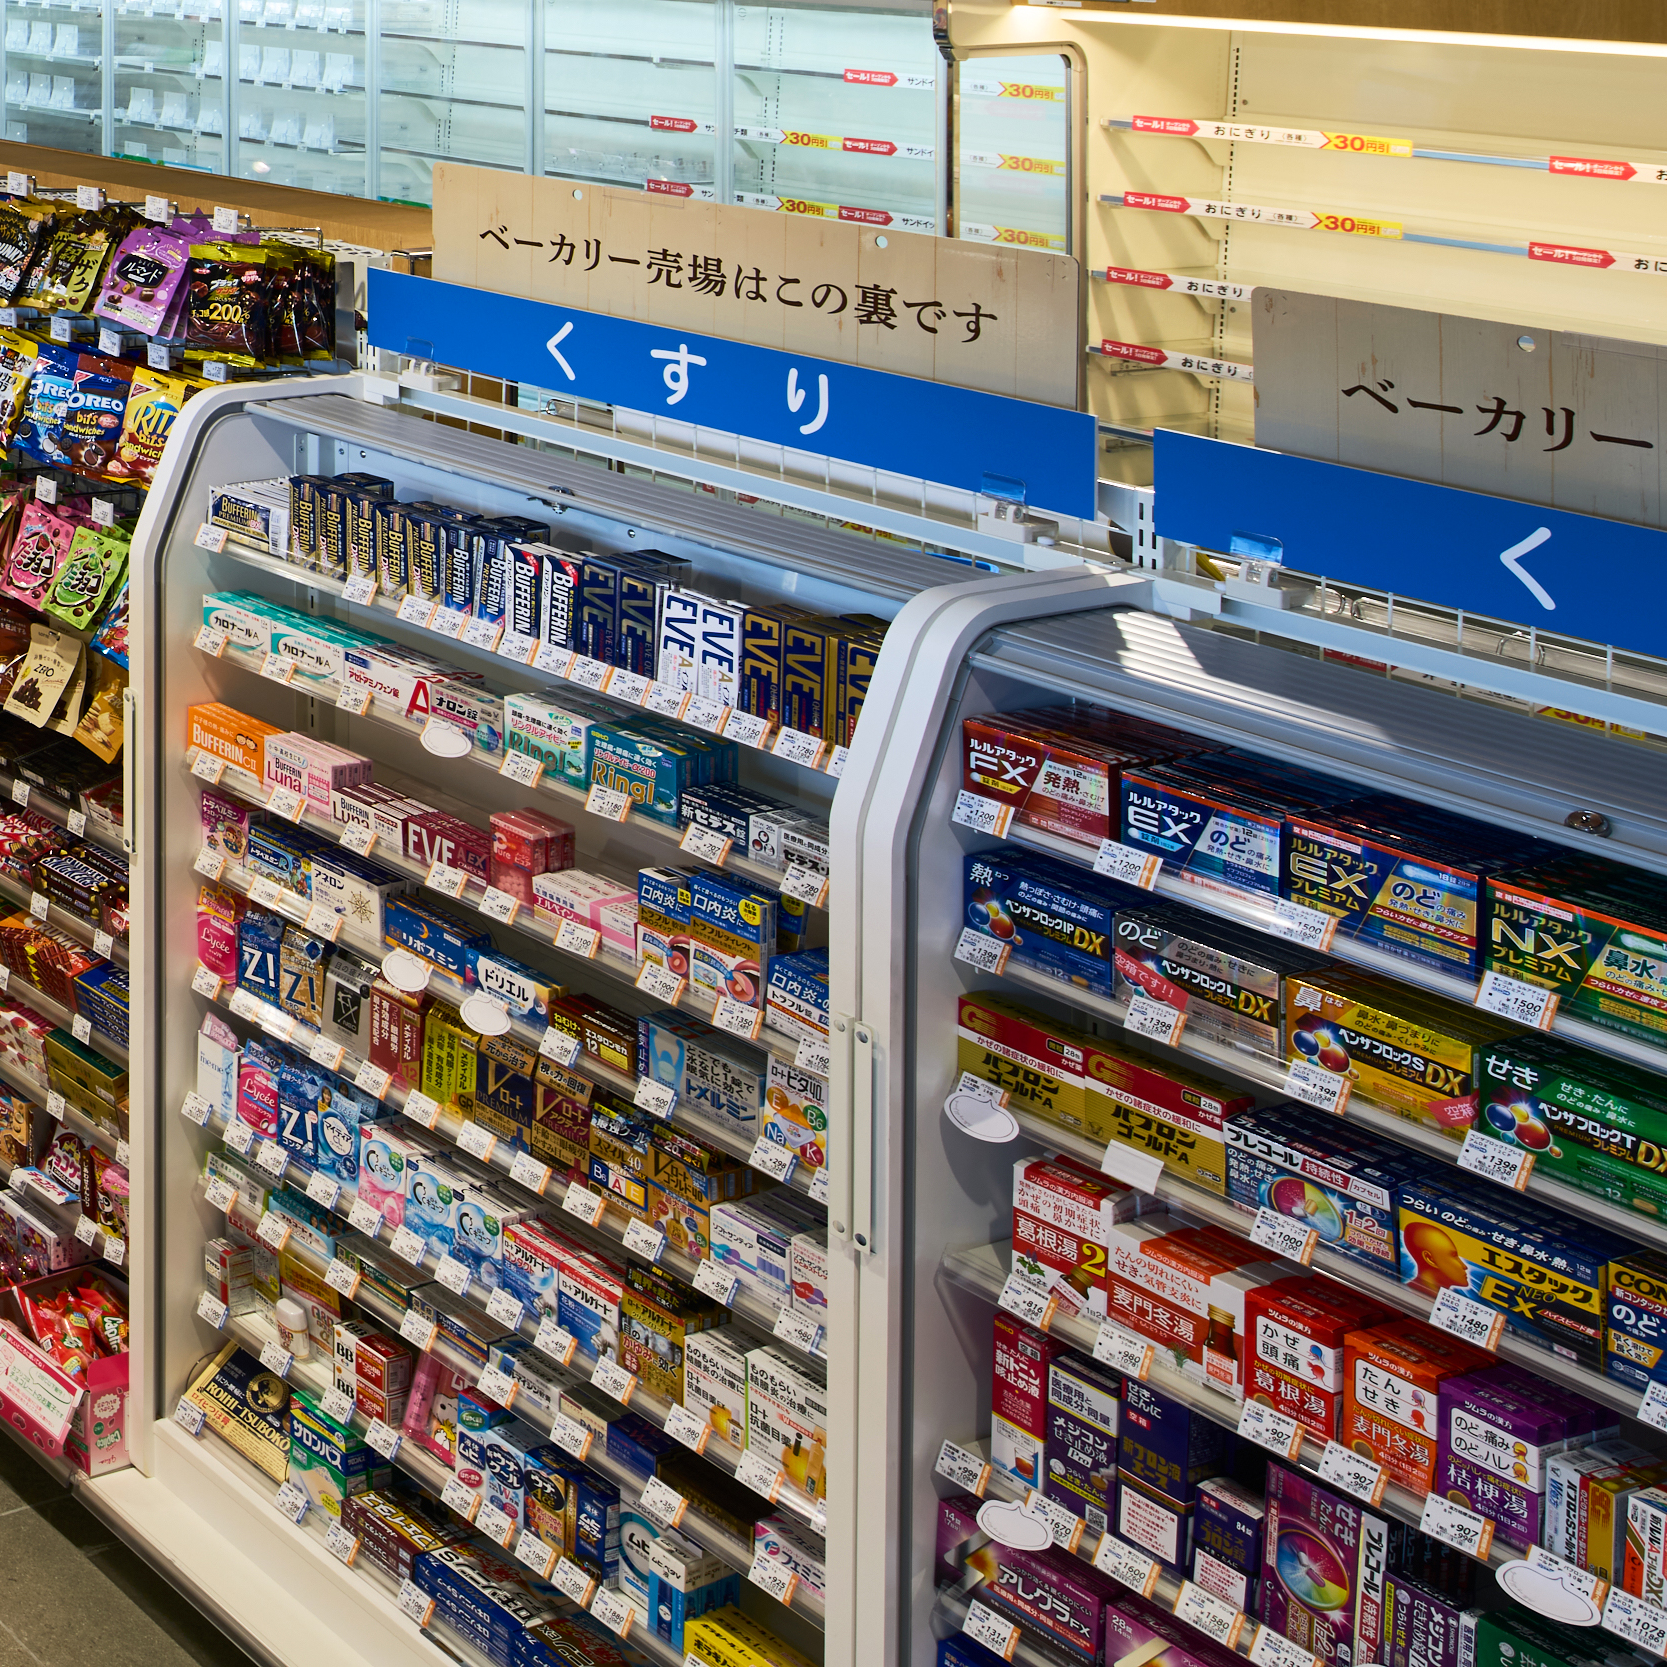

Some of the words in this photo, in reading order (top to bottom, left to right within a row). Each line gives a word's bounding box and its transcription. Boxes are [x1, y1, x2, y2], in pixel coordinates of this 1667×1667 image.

[1009, 84, 1054, 99] 30円引
[789, 133, 828, 147] 30円引
[1134, 116, 1168, 132] セール!
[1214, 124, 1272, 142] おにぎり
[1333, 133, 1391, 155] 30円引
[1008, 156, 1054, 172] 30円引
[785, 200, 825, 216] 30円引
[1125, 193, 1158, 208] セール!
[1205, 203, 1263, 220] おにぎり
[1323, 213, 1383, 236] 30円引
[123, 262, 163, 284] ルマンド
[478, 223, 998, 345] ベーカリー売場はこの裏です
[1107, 268, 1140, 283] セール!
[1186, 280, 1244, 299] おにぎり
[547, 322, 829, 434] くすり
[1181, 357, 1240, 376] おにぎり
[67, 393, 123, 412] OREO
[1341, 379, 1653, 453] ベーカリー
[221, 498, 257, 520] BUFFERIN
[299, 500, 313, 553] BUFFERIN
[327, 511, 341, 564] BUFFERIN
[389, 531, 403, 585] BUFFERIN
[453, 548, 468, 604] BUFFERIN
[515, 562, 534, 633] BUFFERIN
[582, 564, 615, 629] EVE
[213, 616, 259, 641] カロナールA
[663, 594, 698, 658] EVE
[702, 609, 734, 674] EVE
[282, 643, 331, 669] カロナールA
[744, 614, 779, 684] EVE
[349, 670, 400, 699] アセトアミノフェン錠
[436, 696, 478, 721] ナロン錠
[969, 738, 1037, 767] ルルアタック
[970, 751, 1030, 786] FX
[267, 761, 302, 795] Luna
[591, 760, 654, 804] Ringl
[1041, 786, 1102, 811] のどの痛み・鼻水に
[1128, 791, 1202, 824] ルルアタック
[681, 804, 746, 839] 新セデス錠
[1128, 805, 1193, 845] EX
[1210, 829, 1273, 862] のどの痛み
[1291, 837, 1378, 876] ルルアタック
[314, 868, 344, 890] アネロン
[970, 862, 993, 887] 熱
[1290, 852, 1368, 899] EX
[641, 885, 682, 913] 口内炎に
[693, 894, 744, 928] 口内炎に
[1290, 877, 1360, 912] プレミアム
[1391, 880, 1467, 921] のどの痛み
[1073, 926, 1106, 957] DX
[1118, 920, 1163, 950] のど
[1493, 902, 1592, 944] ルルアタック
[401, 933, 457, 970] リポスミン
[1492, 918, 1581, 971] NX
[484, 970, 529, 1003] ドリエル
[1338, 1027, 1424, 1072] ベンザブロックS
[1425, 1060, 1467, 1097] DX
[1485, 1054, 1540, 1092] せき
[685, 1078, 756, 1122] トメルミン
[1105, 1086, 1202, 1133] かぜの諸症状の緩和に
[1111, 1104, 1197, 1150] パブロン
[1117, 1122, 1190, 1165] ゴールドA
[1226, 1129, 1300, 1168] プレコール
[1305, 1161, 1345, 1187] 持続性
[1016, 1216, 1079, 1262] 葛根湯
[1081, 1242, 1107, 1278] 2
[1114, 1245, 1199, 1294] たんの切れにくい
[1482, 1246, 1593, 1305] エスタック
[1490, 1278, 1543, 1319] EX
[1519, 1284, 1558, 1303] NEO
[1113, 1286, 1195, 1344] 麦門冬湯
[1262, 1322, 1299, 1351] かぜ
[1262, 1340, 1301, 1371] 頭痛
[750, 1363, 797, 1396] ものもらい
[1253, 1368, 1327, 1419] 葛根湯
[1361, 1366, 1401, 1396] たん
[1361, 1384, 1400, 1413] せき
[292, 1420, 342, 1469] サロンパス
[1053, 1415, 1108, 1449] メジコン
[1352, 1415, 1430, 1468] 麦門冬湯
[1069, 1448, 1091, 1467] Pro
[1454, 1433, 1511, 1472] のどのハレ
[1447, 1464, 1528, 1520] 桔梗湯
